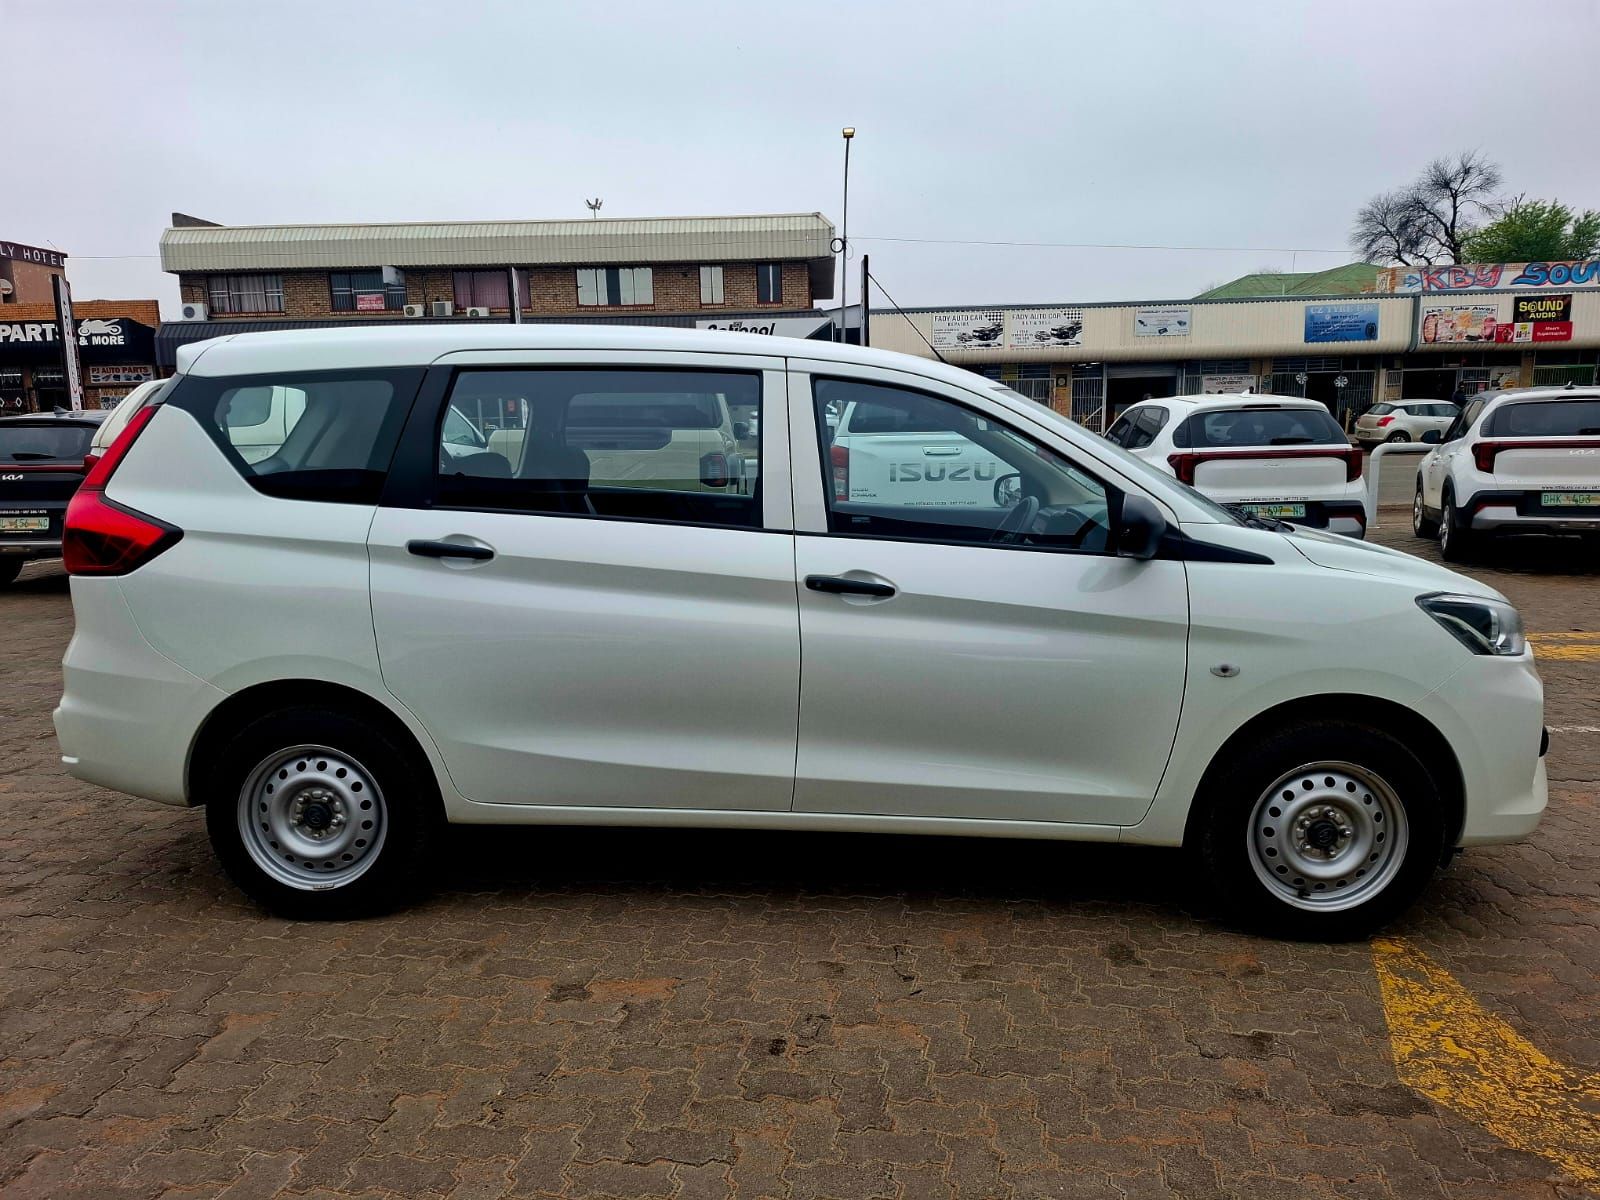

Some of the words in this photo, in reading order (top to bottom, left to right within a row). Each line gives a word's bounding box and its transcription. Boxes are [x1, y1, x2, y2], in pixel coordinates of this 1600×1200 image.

[23, 248, 65, 266] HOTEL
[1511, 260, 1600, 286] SOU
[1529, 311, 1557, 319] AUDIO
[0, 323, 59, 342] PART
[79, 336, 88, 346] &
[92, 335, 125, 346] MORE
[122, 366, 149, 374] PARTS
[889, 463, 996, 482] ISUZU
